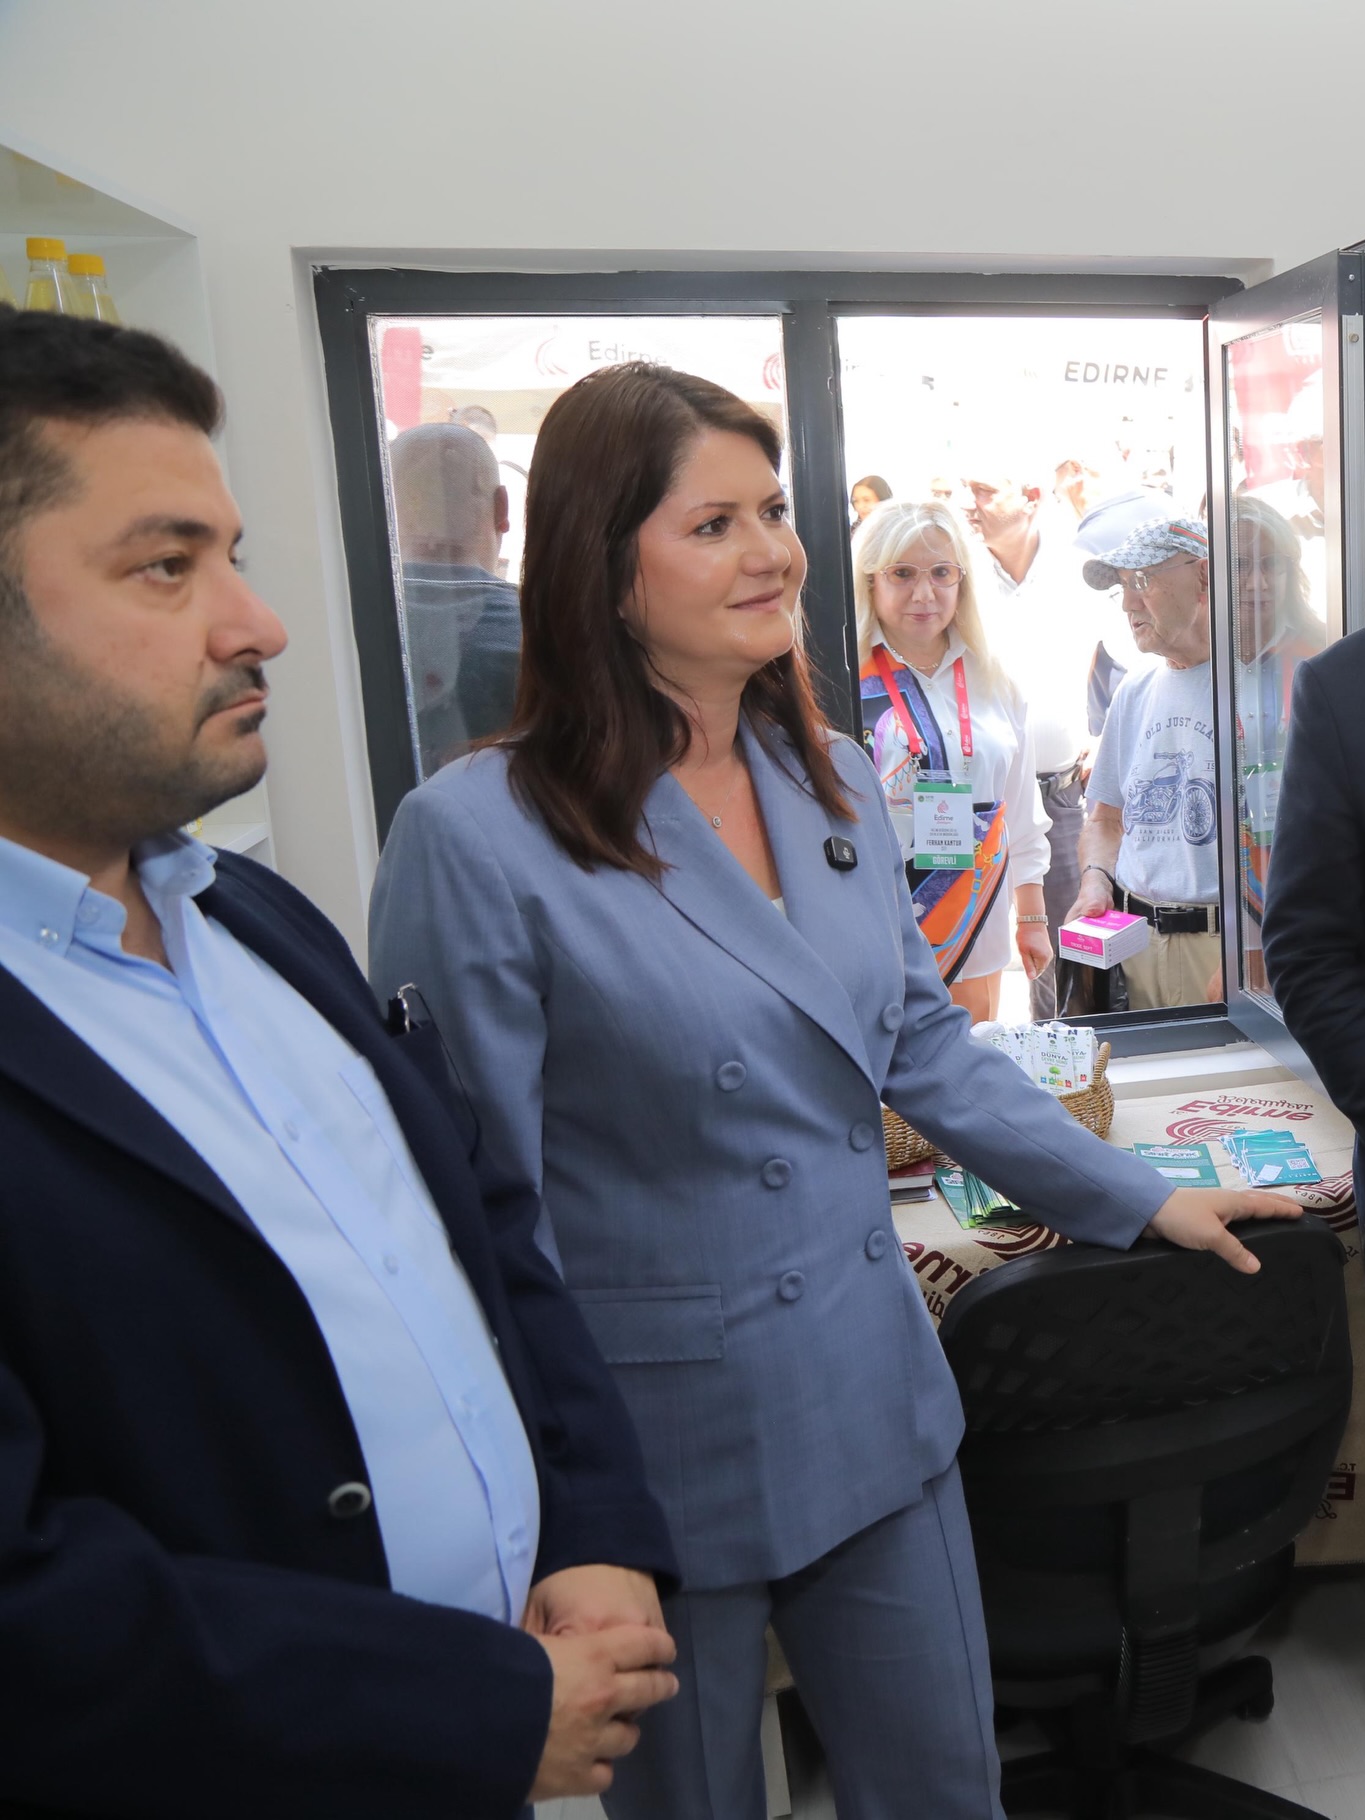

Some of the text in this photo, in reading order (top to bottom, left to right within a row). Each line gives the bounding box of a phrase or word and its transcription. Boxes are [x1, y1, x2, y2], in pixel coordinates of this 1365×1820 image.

[1145, 716, 1214, 742] OLD JUST CLA
